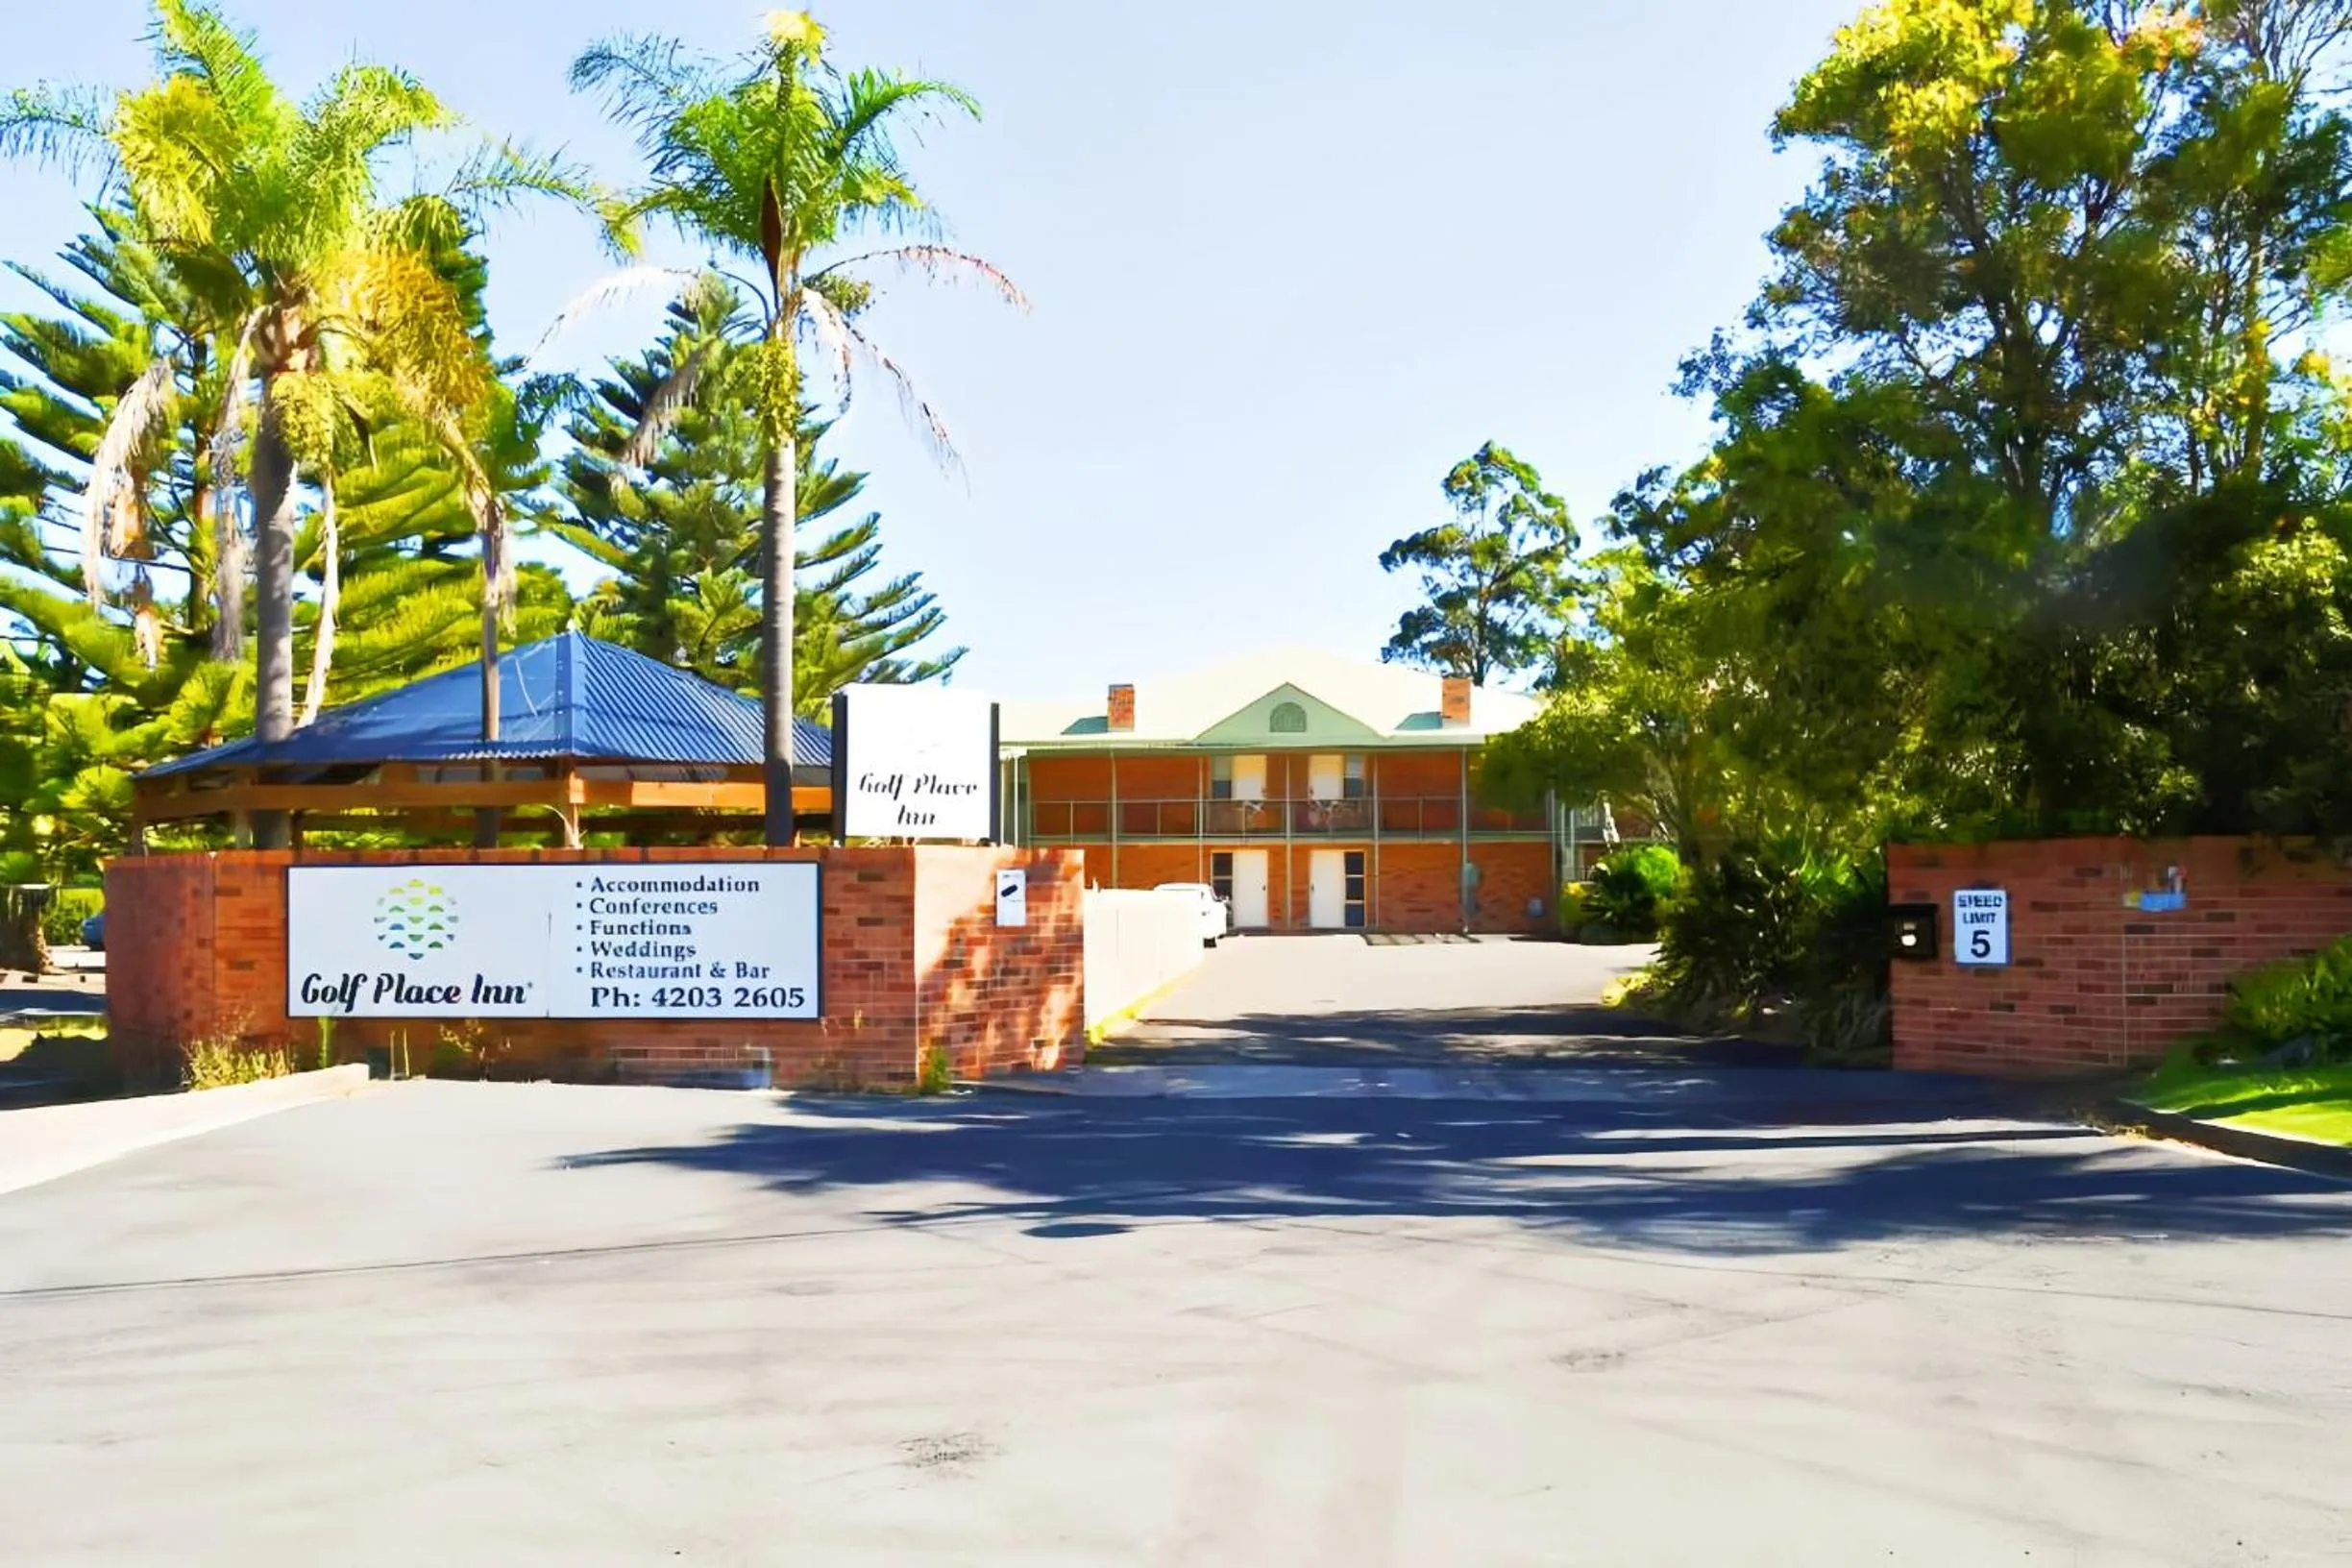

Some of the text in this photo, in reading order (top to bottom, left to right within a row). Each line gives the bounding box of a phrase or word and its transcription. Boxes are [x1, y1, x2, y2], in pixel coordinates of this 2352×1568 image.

[590, 875, 760, 894] Accommodation
[589, 897, 719, 915] Conferences
[1957, 894, 2003, 908] SPEED
[1963, 912, 1997, 924] LIMIT
[590, 919, 692, 936] Functions
[590, 941, 698, 962] Weddings
[1970, 930, 1992, 959] 5
[590, 962, 771, 978] Restaurant & Bar
[301, 973, 527, 1014] Golf Place Inn
[591, 987, 806, 1008] Ph: 4203 2605
